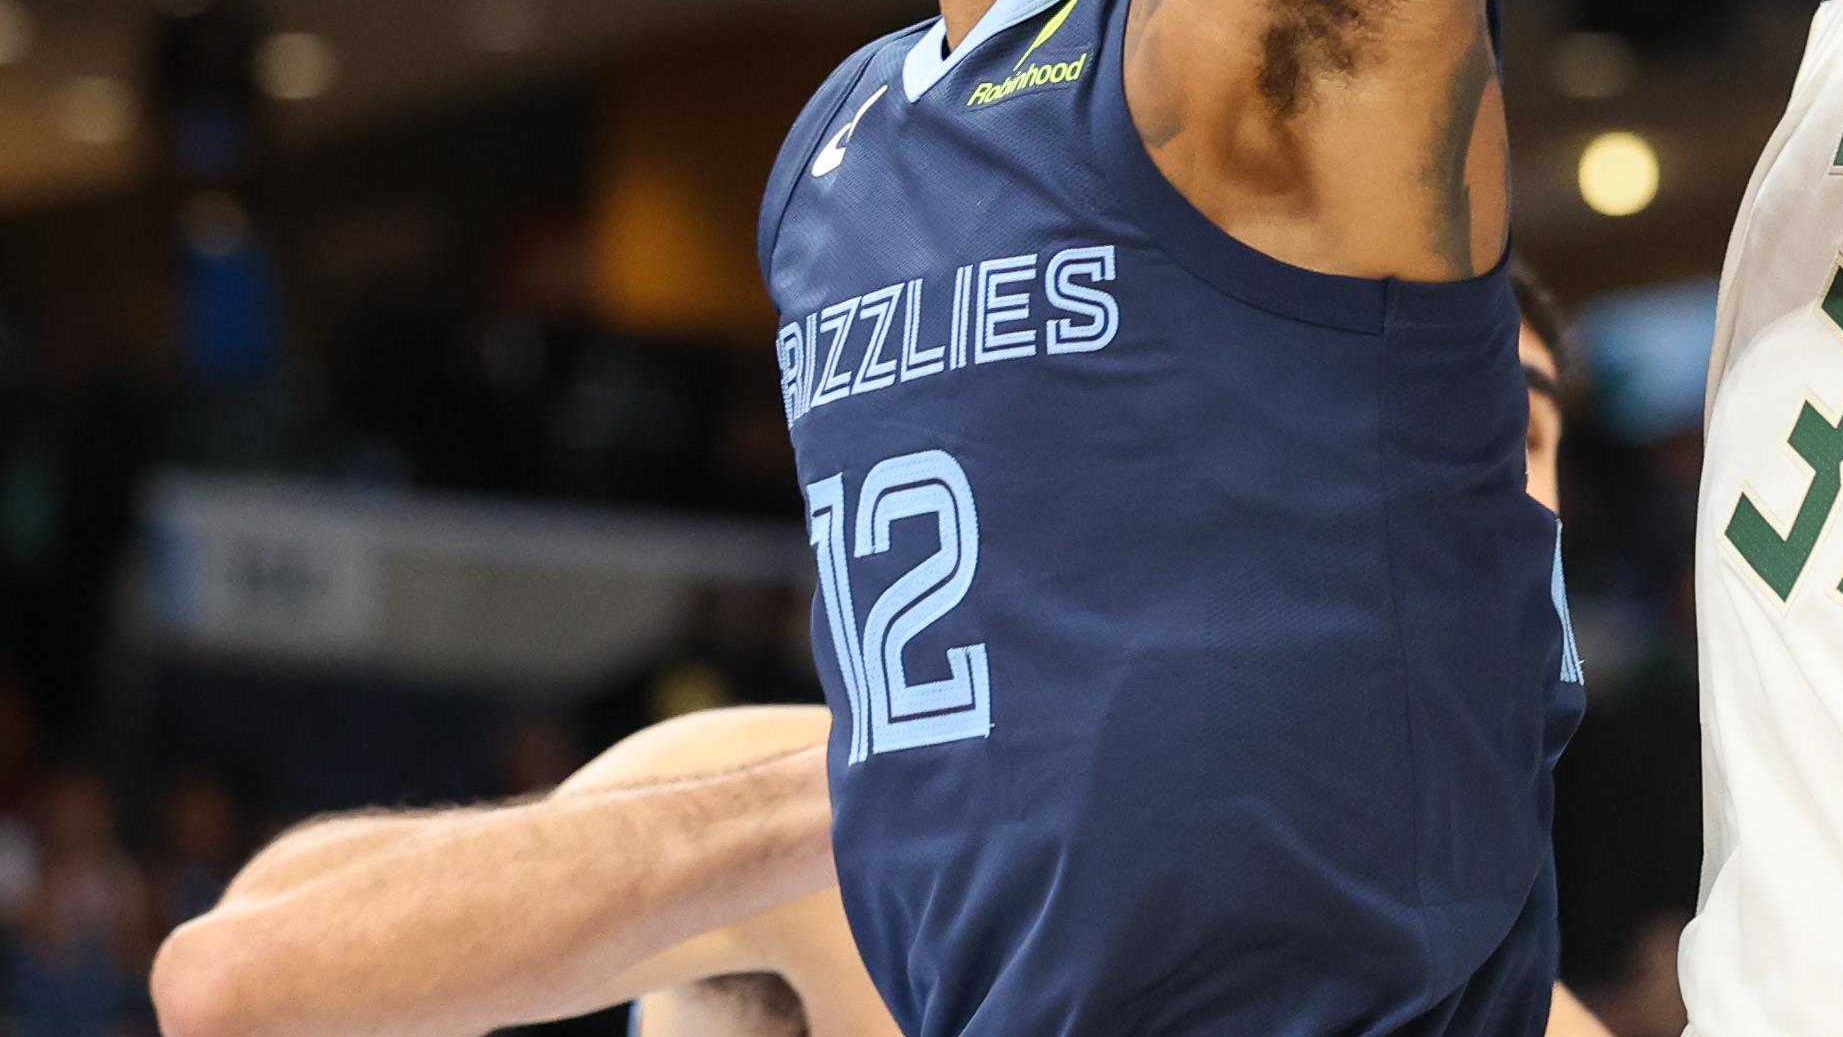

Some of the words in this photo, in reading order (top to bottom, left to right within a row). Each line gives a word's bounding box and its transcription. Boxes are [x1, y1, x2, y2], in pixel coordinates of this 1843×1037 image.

[967, 53, 1087, 106] Robinhood
[776, 244, 1119, 430] RIZZLIES
[806, 450, 994, 766] 12
